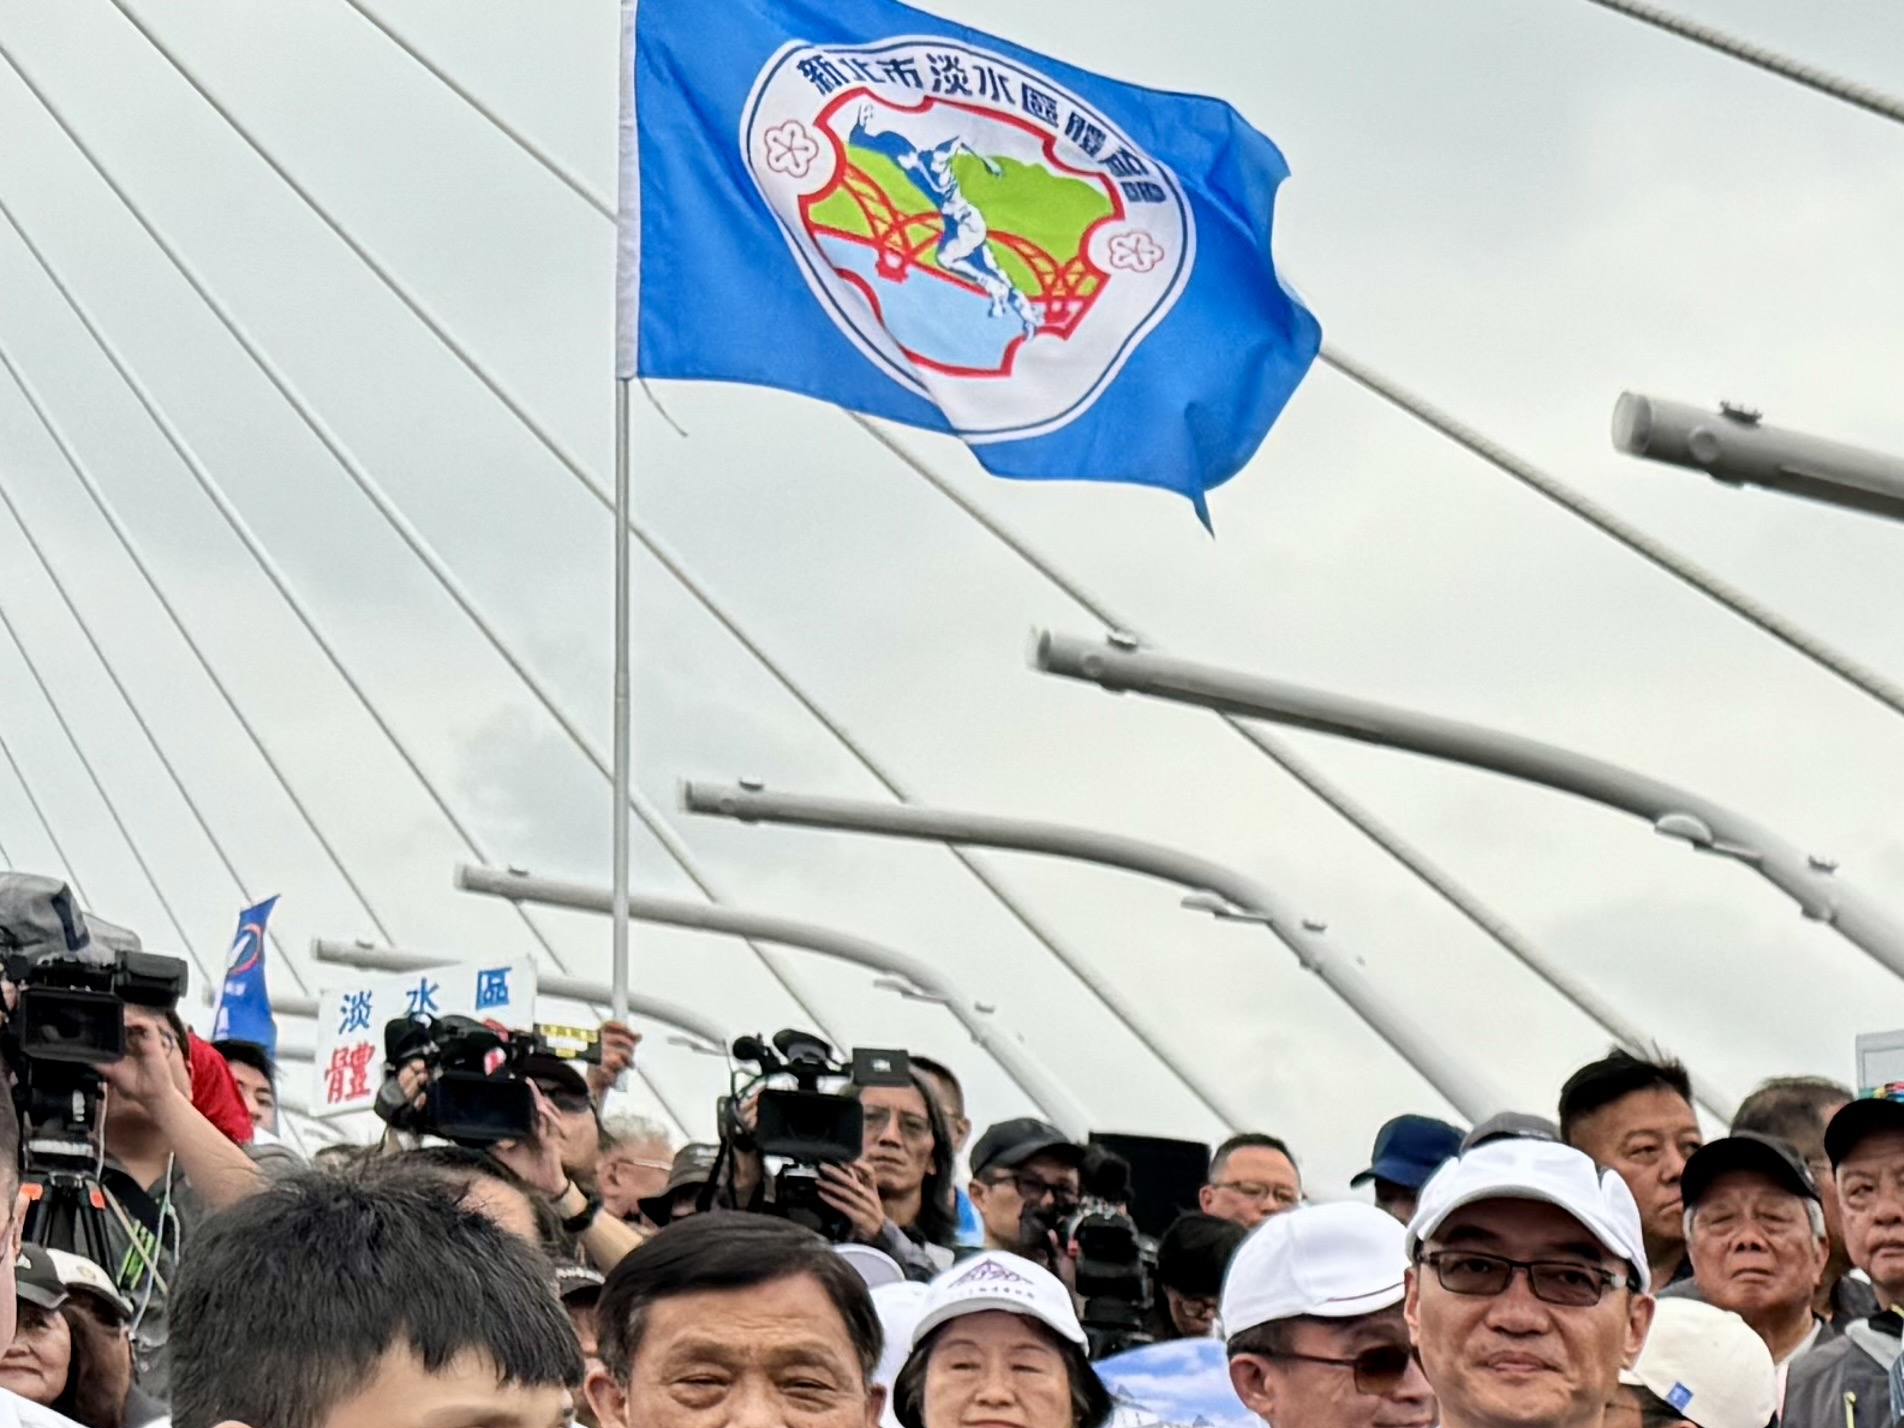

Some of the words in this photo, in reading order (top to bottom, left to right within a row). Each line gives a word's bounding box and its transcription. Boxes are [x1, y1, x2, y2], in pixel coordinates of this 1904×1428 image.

[337, 967, 512, 1034] 淡水區
[324, 1042, 376, 1104] 體
